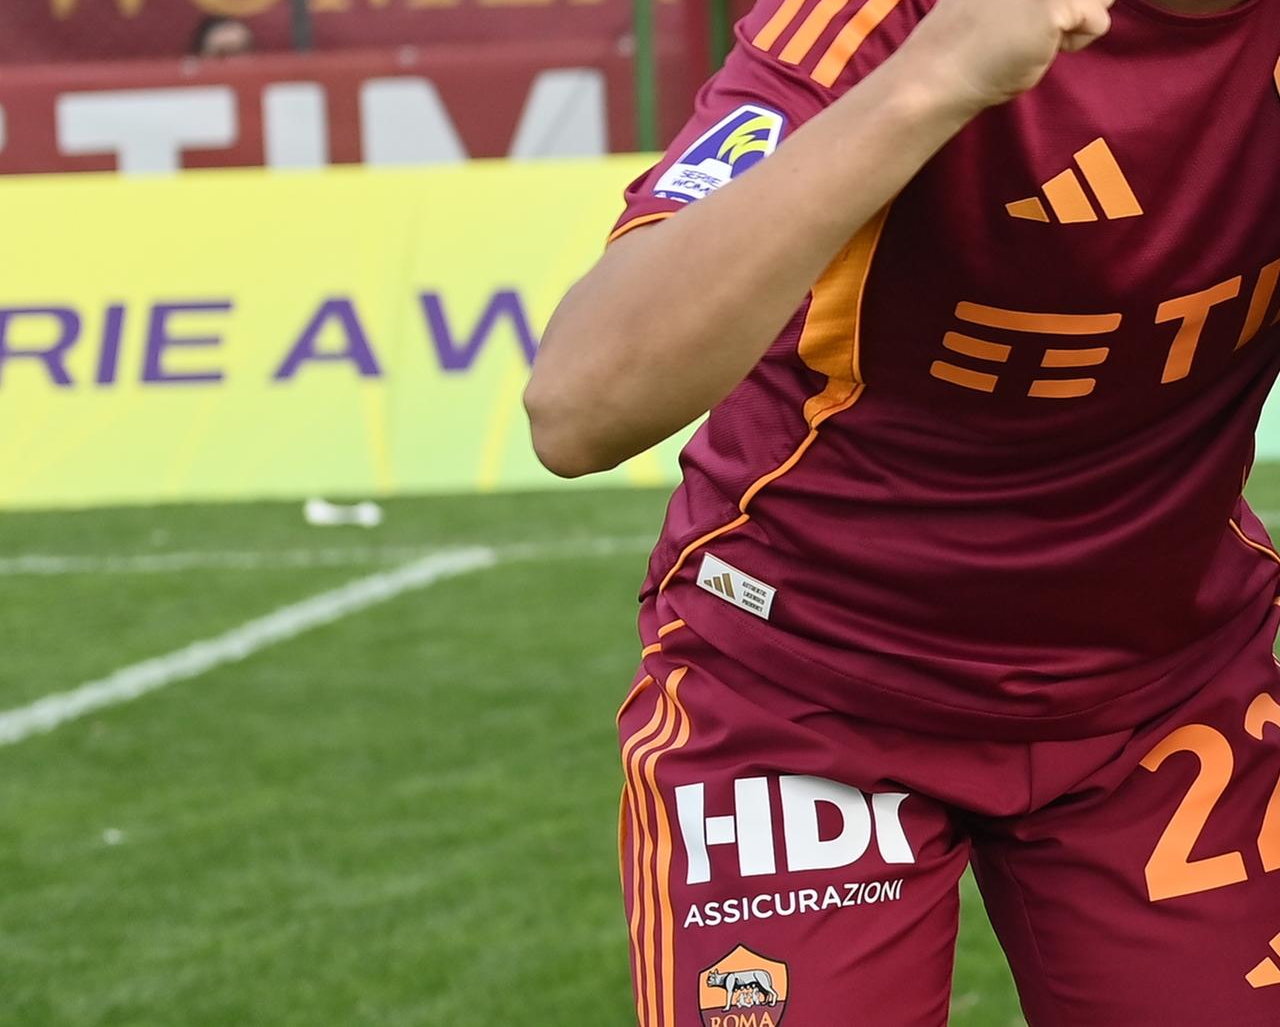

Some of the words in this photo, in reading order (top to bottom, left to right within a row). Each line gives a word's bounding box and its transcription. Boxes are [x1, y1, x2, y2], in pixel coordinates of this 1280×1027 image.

[273, 297, 383, 382] A
[674, 775, 916, 885] HDI
[683, 879, 904, 929] ASSICURAZIONI
[710, 1011, 776, 1027] ROMA
